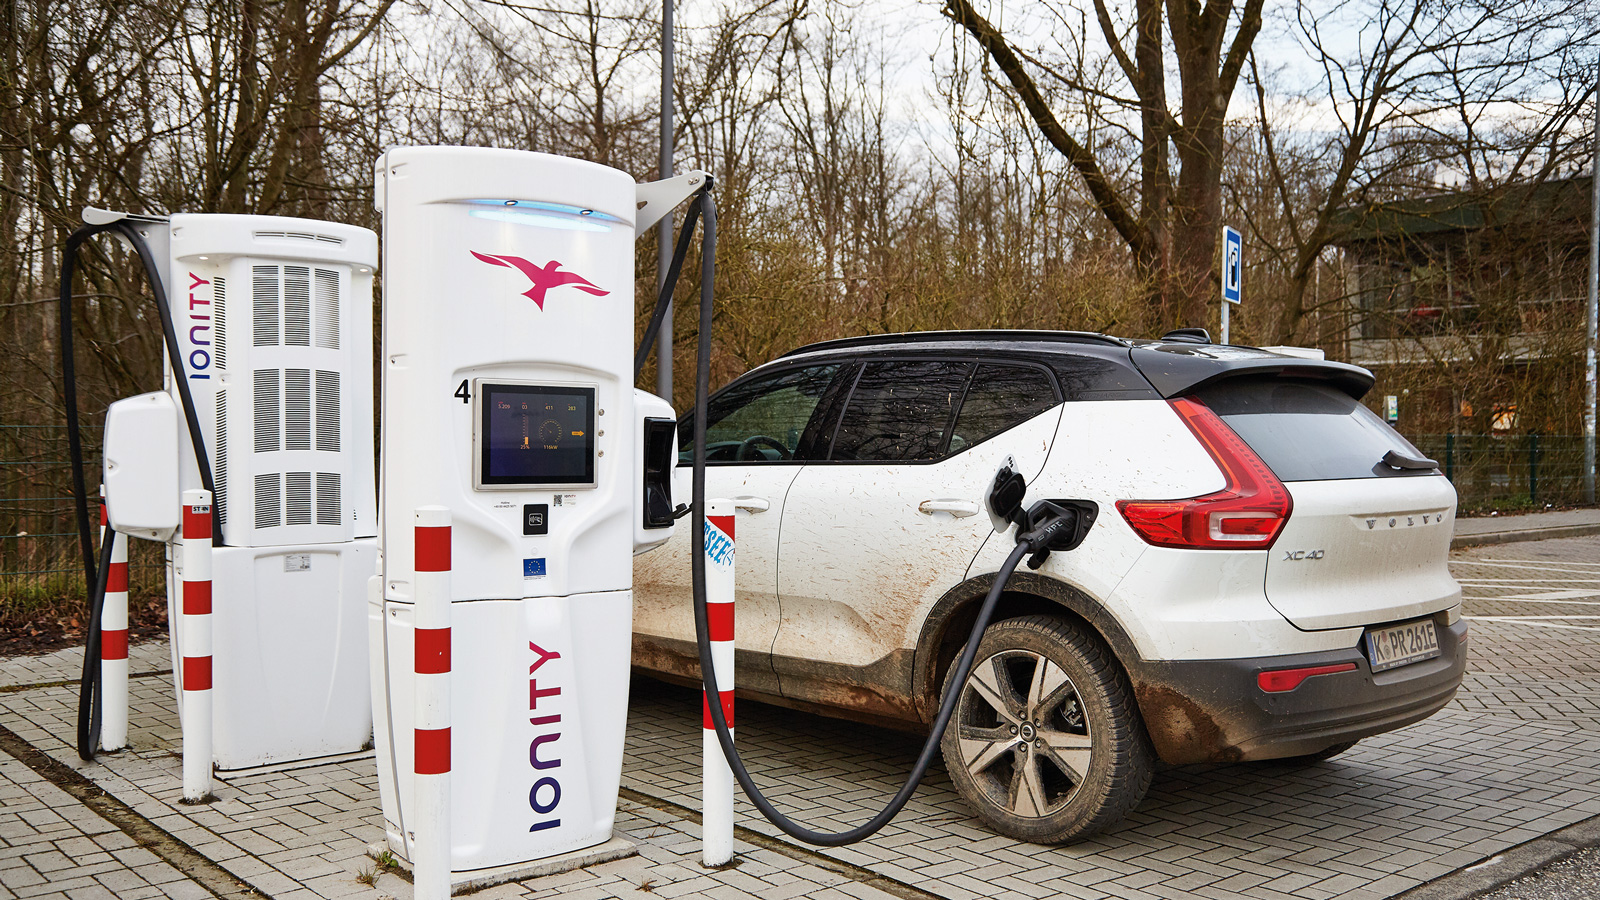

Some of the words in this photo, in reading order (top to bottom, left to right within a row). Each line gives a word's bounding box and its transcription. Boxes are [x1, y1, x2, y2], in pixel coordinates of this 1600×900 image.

[189, 272, 210, 379] IONITY
[454, 379, 471, 404] 4
[1045, 521, 1063, 534] HPC
[1366, 513, 1442, 530] VOLVO
[1373, 635, 1385, 661] K
[1389, 630, 1408, 657] PR
[1407, 624, 1436, 653] 261E
[529, 641, 561, 832] IONITY
